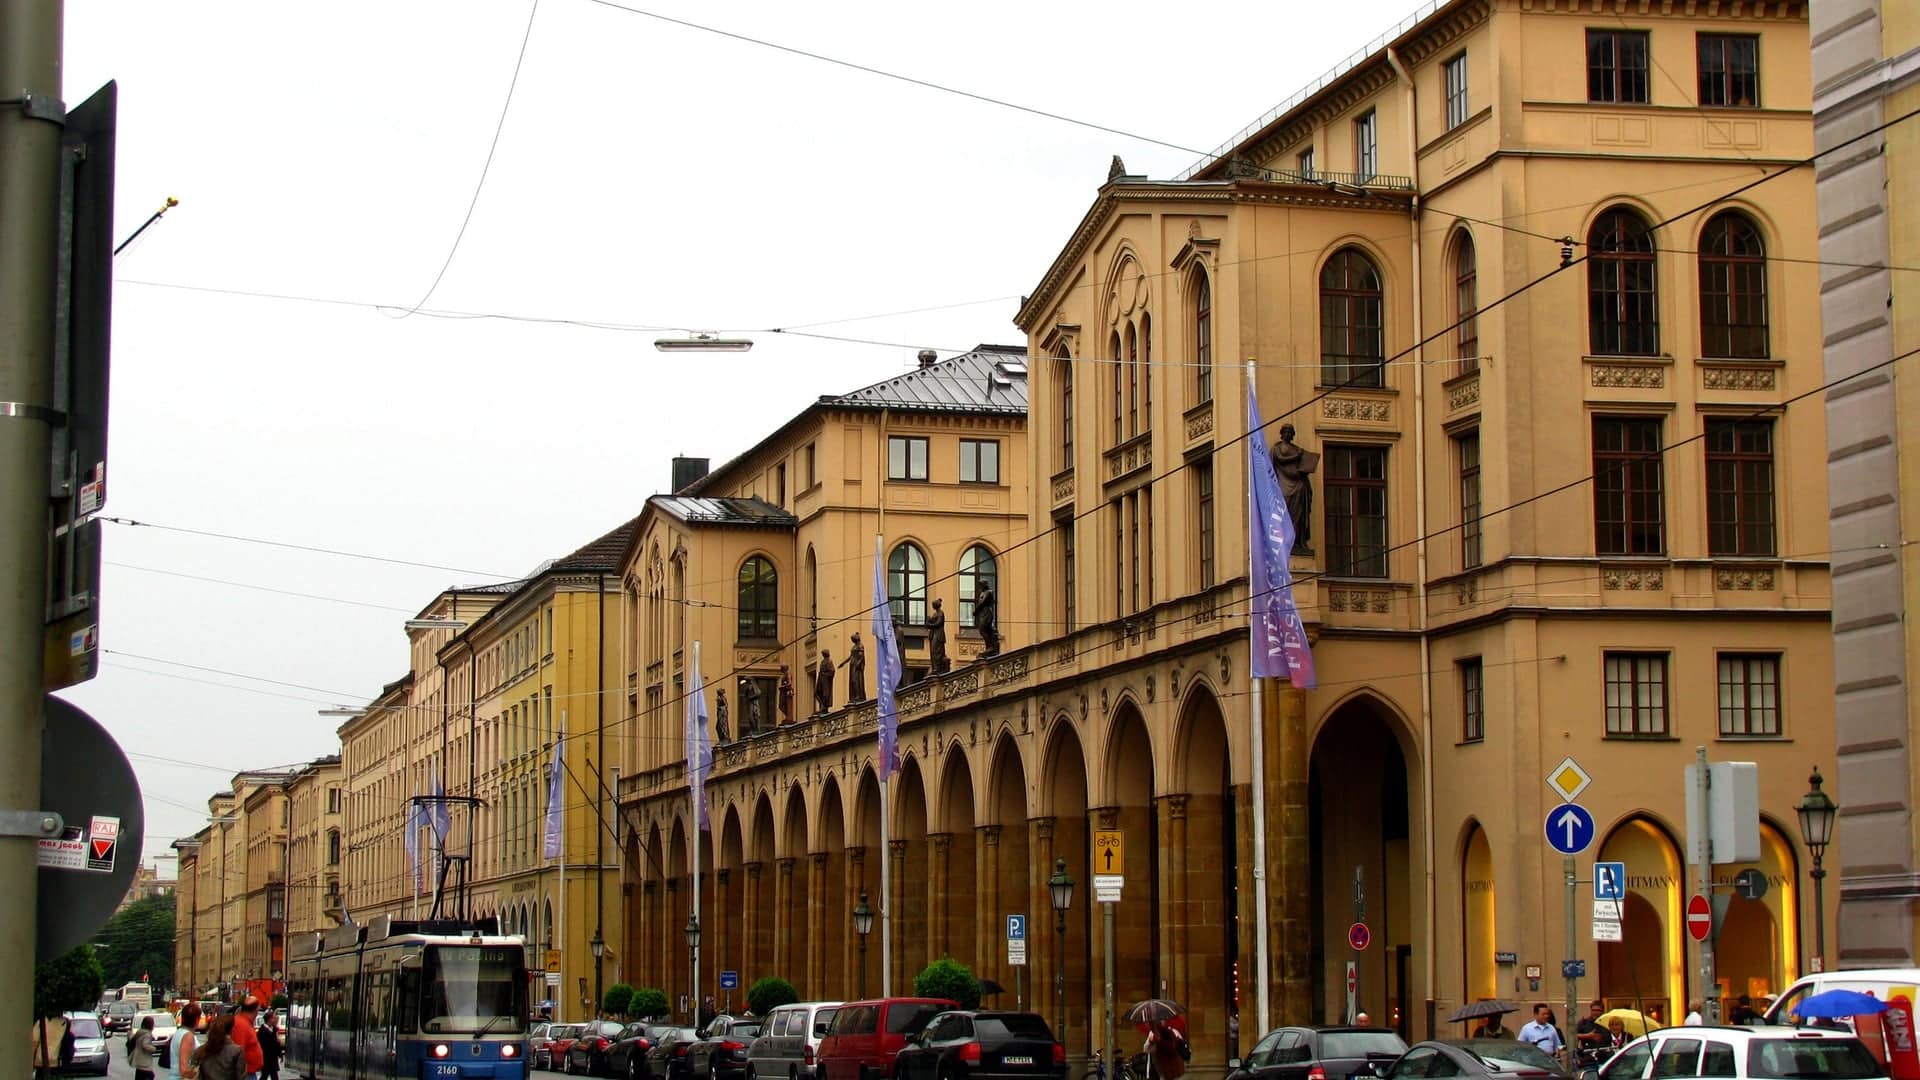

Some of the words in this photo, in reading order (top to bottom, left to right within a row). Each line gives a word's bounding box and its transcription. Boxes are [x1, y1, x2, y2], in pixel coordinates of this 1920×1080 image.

[94, 822, 115, 834] RAL
[1010, 918, 1020, 937] P
[436, 1065, 458, 1075] 2160
